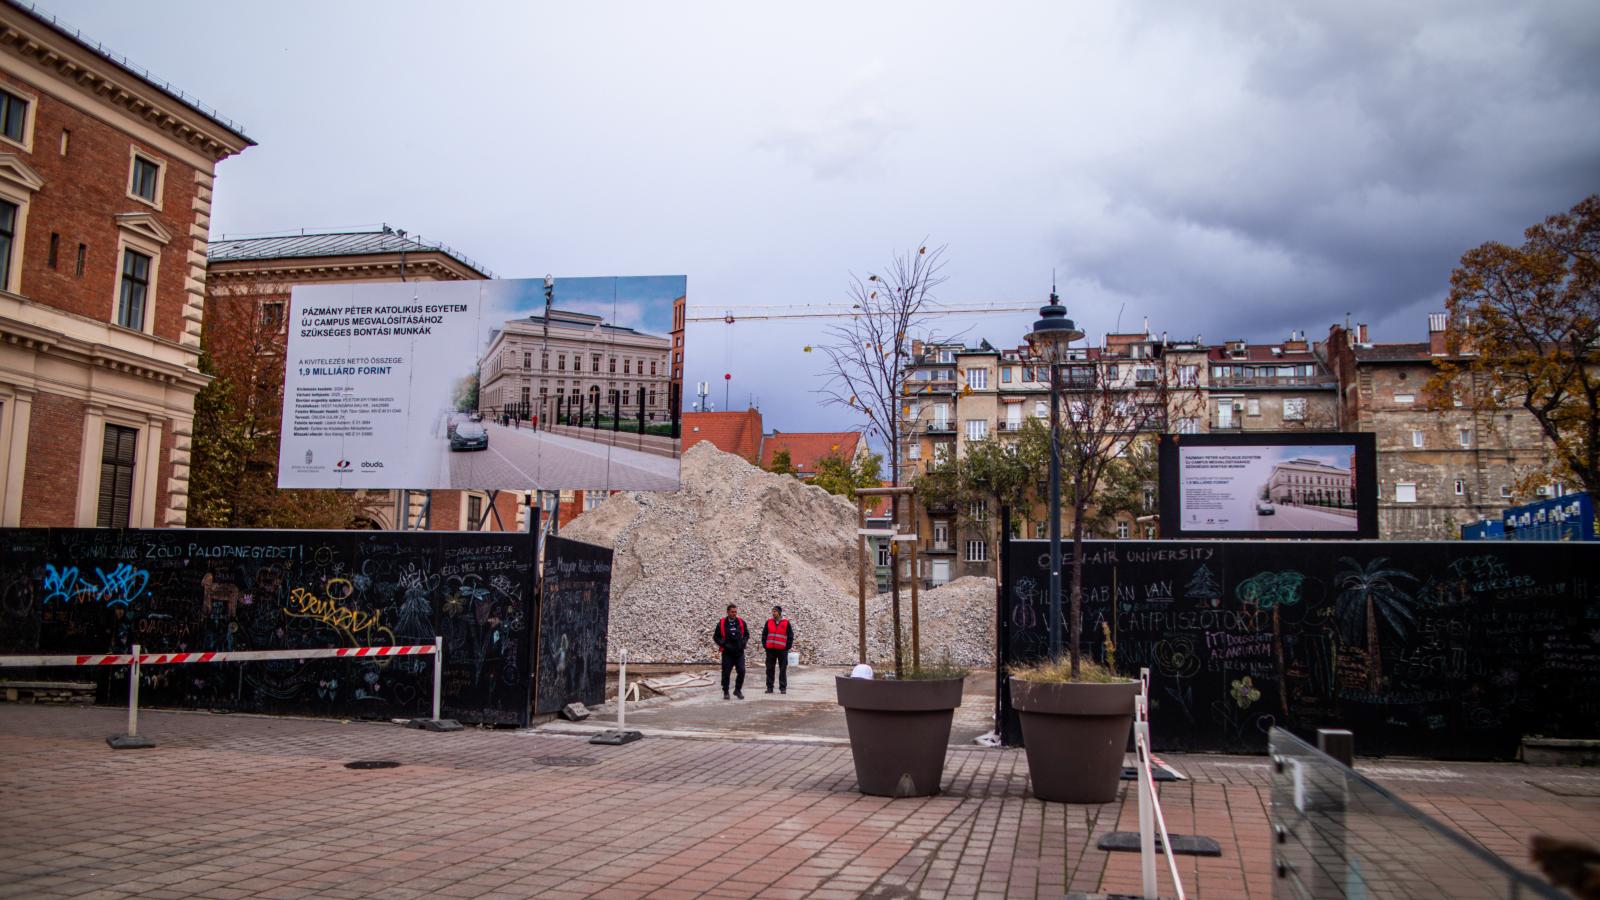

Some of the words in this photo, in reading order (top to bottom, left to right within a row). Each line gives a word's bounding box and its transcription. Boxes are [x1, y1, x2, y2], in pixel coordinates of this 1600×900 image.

[302, 306, 343, 316] PÁZMÁNY
[344, 305, 373, 315] PÉTER
[374, 304, 423, 314] KATOLIKUS
[425, 304, 468, 313] EGYETEM
[301, 318, 312, 327] ÚJ
[314, 318, 350, 326] CAMPUS
[351, 315, 443, 325] MEGVALÓSÍTÁSÁHOZ
[300, 328, 351, 337] SZÜKSÉGES
[353, 327, 391, 336] BONTÁSI
[393, 326, 432, 335] MUNKÁK
[299, 367, 310, 376] 1,9
[312, 366, 356, 376] MILLIÁRD
[357, 366, 392, 375] FORINT
[145, 543, 183, 558] ZÖLD
[1144, 579, 1174, 598] VAN
